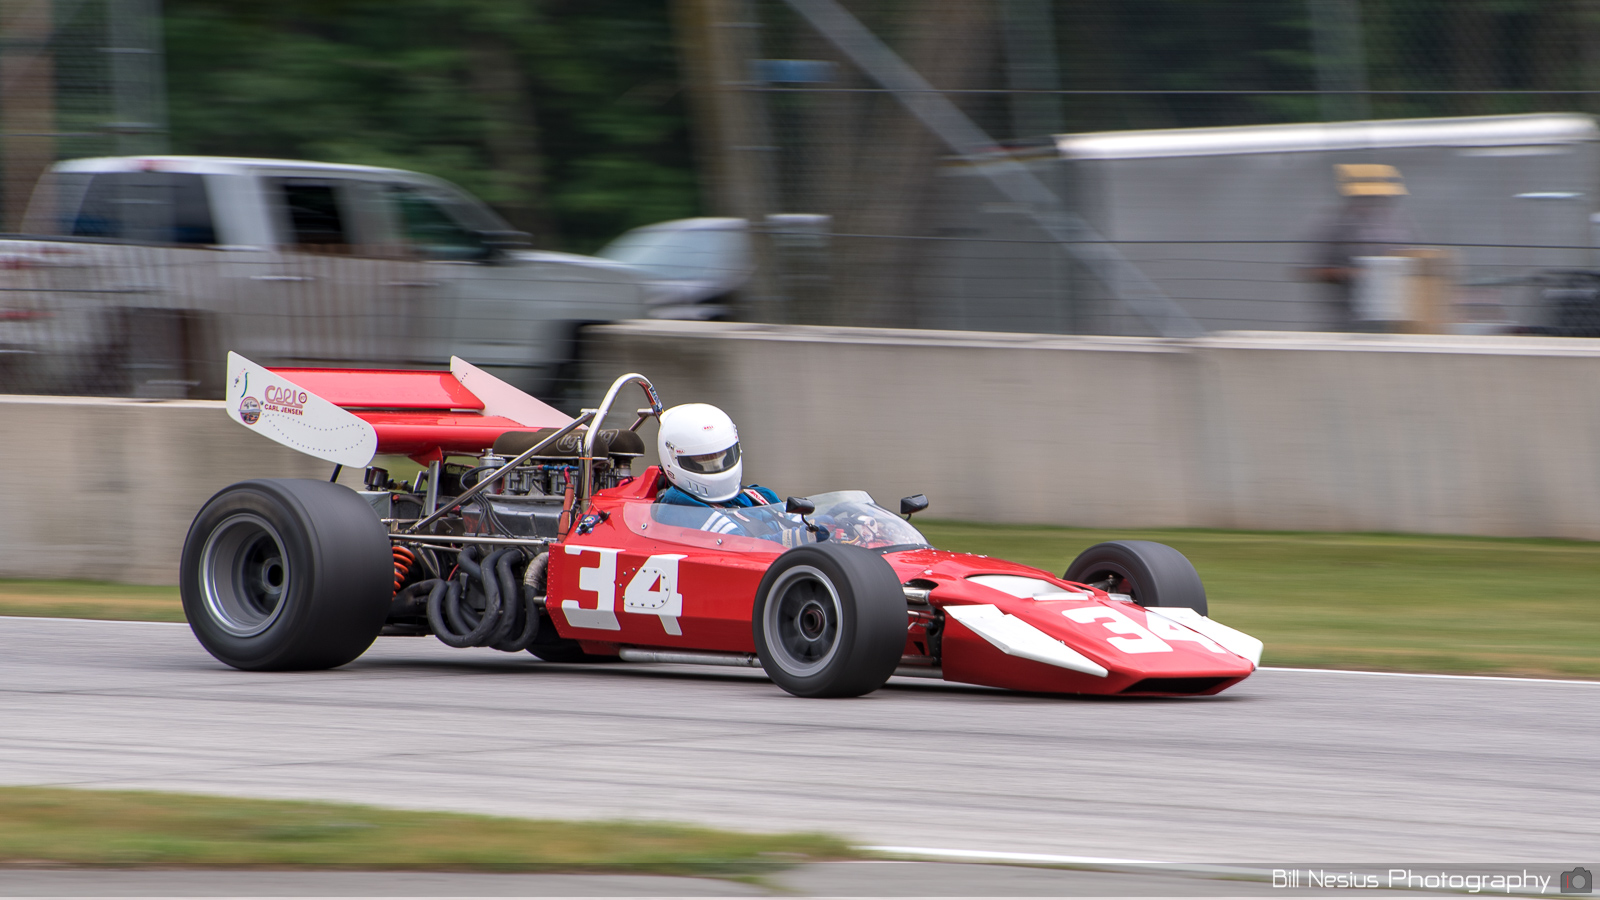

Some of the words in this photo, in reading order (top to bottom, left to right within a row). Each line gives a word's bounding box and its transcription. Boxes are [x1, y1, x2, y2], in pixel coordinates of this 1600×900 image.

[264, 403, 280, 412] CARL
[281, 407, 303, 415] JENSEN
[561, 545, 689, 636] 34
[1061, 606, 1227, 654] 34
